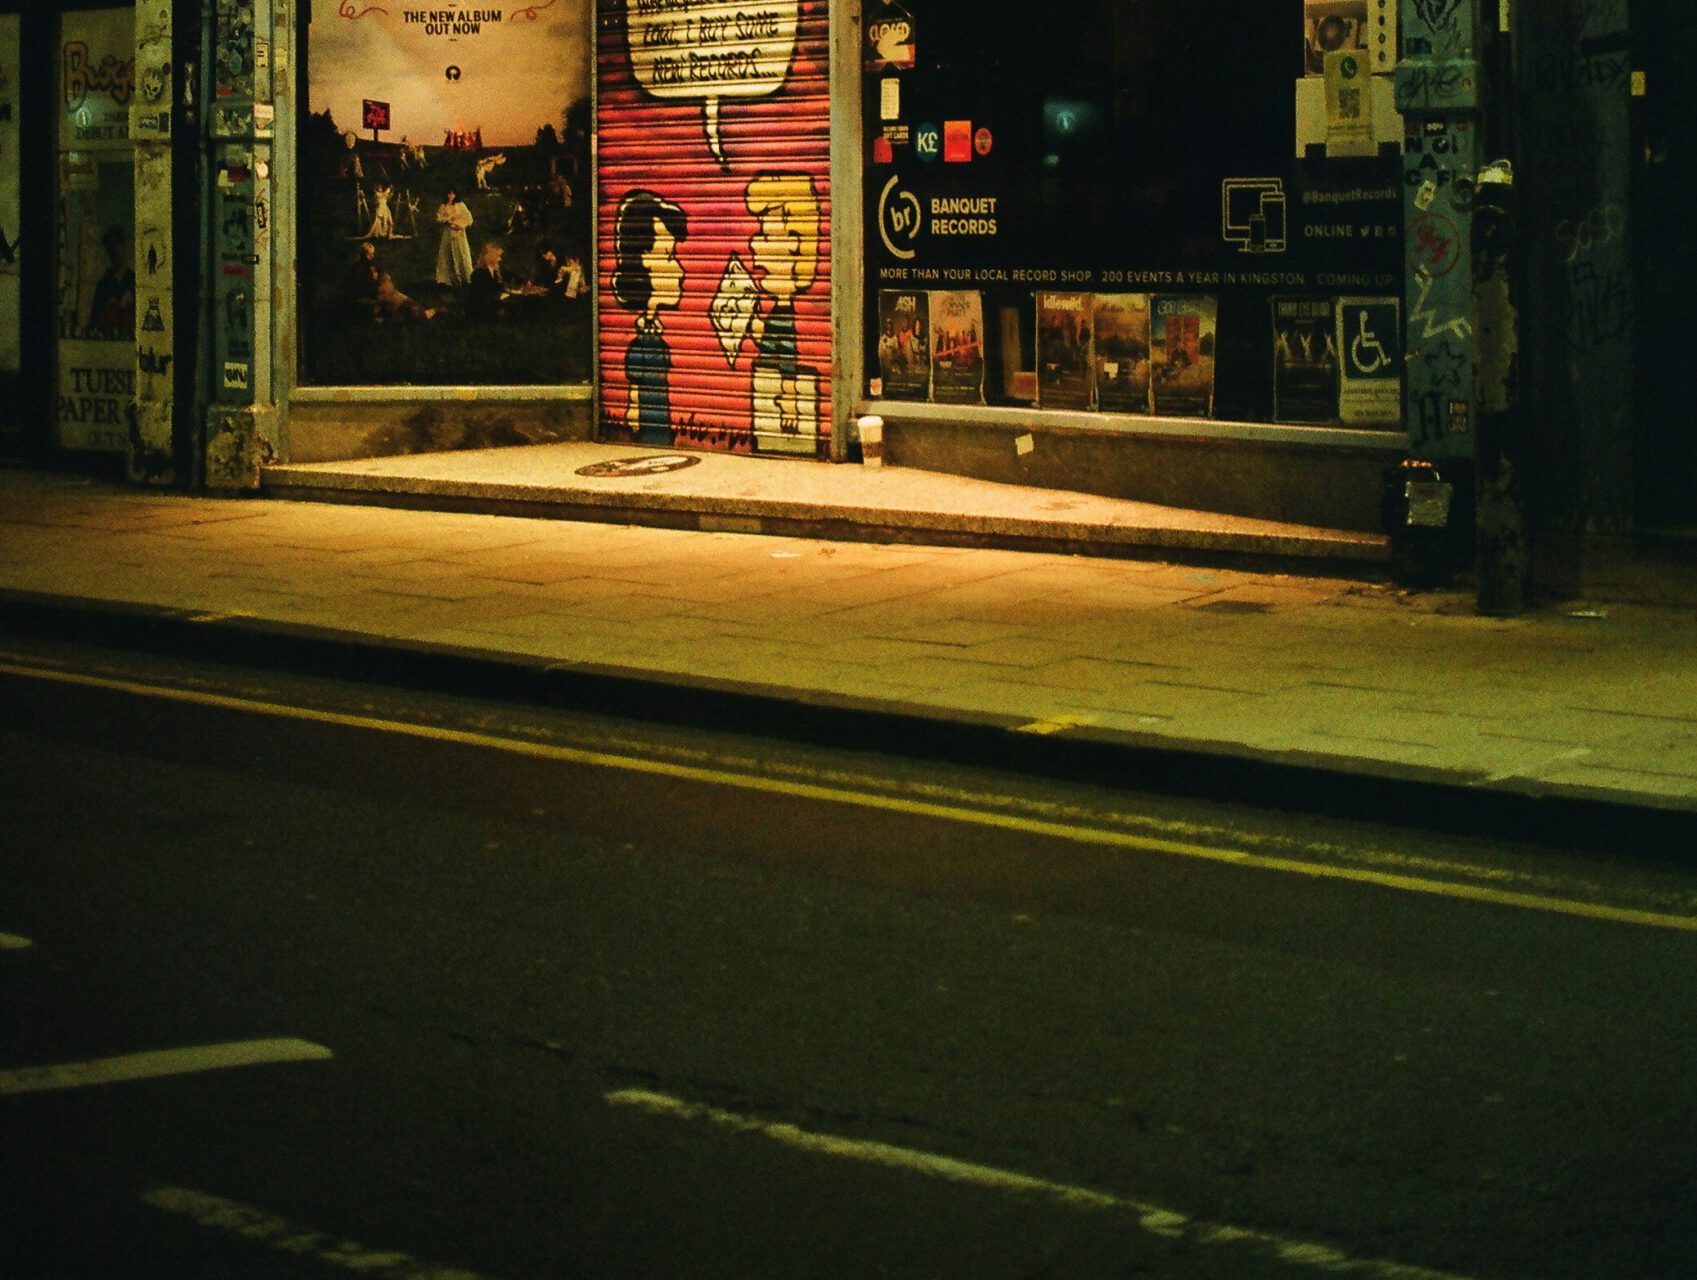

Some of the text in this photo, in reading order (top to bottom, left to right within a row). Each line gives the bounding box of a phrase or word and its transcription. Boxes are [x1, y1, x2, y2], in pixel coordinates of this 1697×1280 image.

[403, 10, 502, 24] THE NEW ALBUM
[425, 22, 481, 36] OUT NOW
[735, 10, 780, 41] SOME
[930, 196, 997, 215] BANQUET
[890, 204, 912, 233] br
[930, 218, 998, 236] RECORDS
[1304, 223, 1353, 238] ONLINE
[879, 267, 908, 280] MORE
[911, 268, 941, 280] THAN
[943, 268, 972, 281] YOUR
[974, 269, 1009, 282] LOCAL
[1012, 269, 1057, 283] RECORD
[1101, 271, 1124, 284] 200
[1127, 271, 1172, 285] EVENTS
[1175, 272, 1185, 284] A
[1187, 272, 1219, 285] YEAR
[1223, 272, 1236, 285] IN
[1316, 273, 1394, 287] COMING UP
[894, 295, 917, 312] ASH
